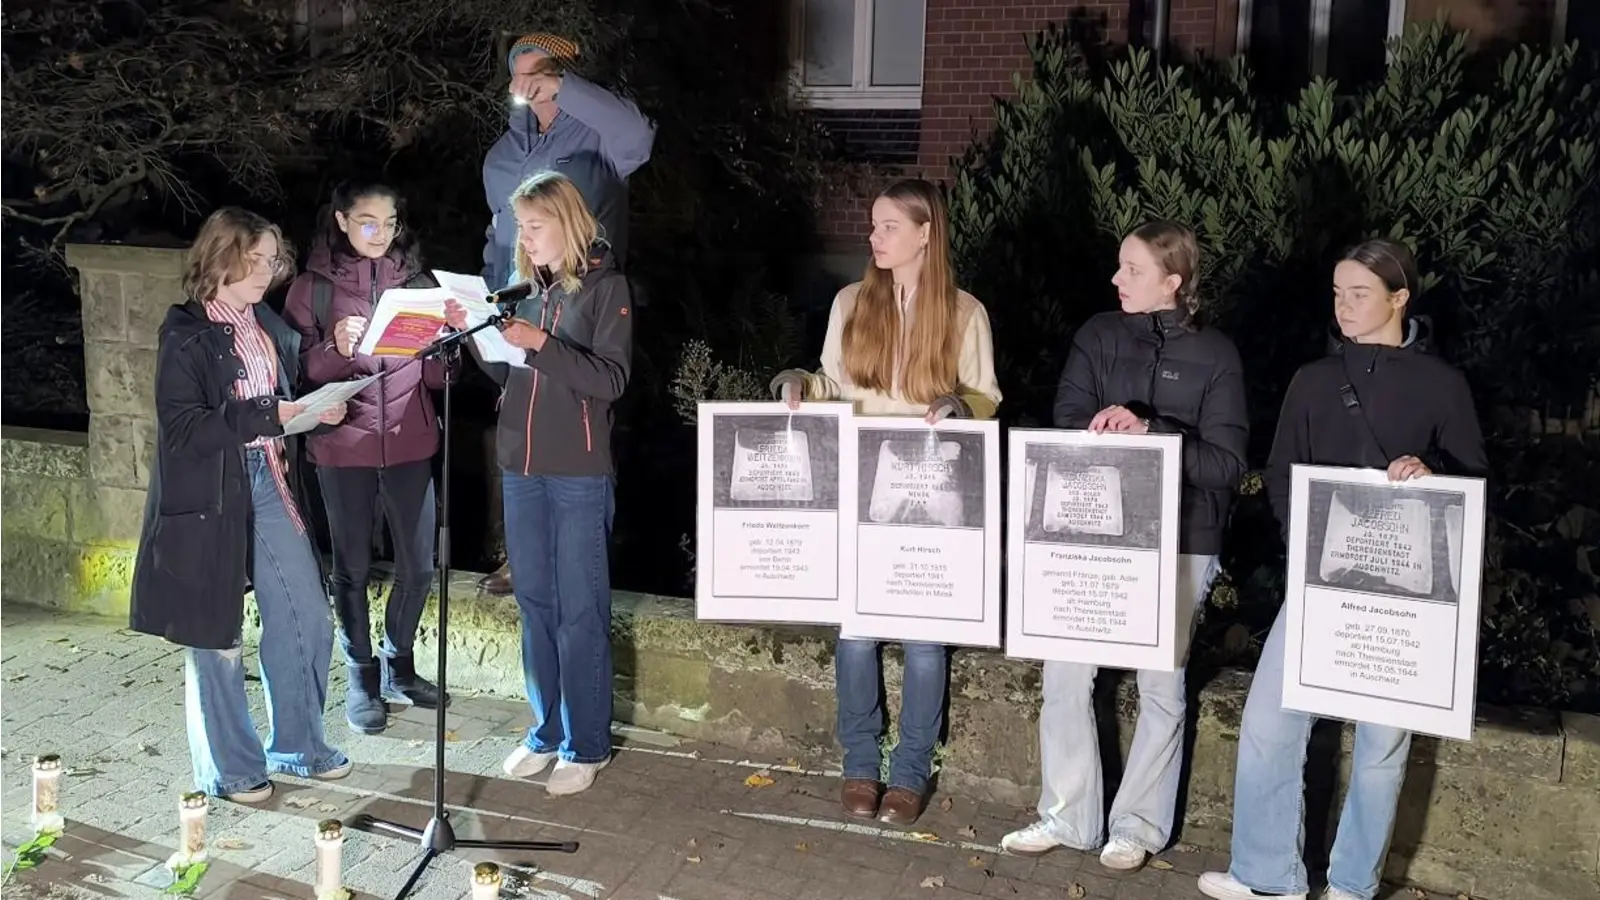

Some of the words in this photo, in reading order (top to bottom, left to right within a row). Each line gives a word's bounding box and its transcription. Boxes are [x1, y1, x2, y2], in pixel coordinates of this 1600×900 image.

[1351, 518, 1410, 534] JACOBSOHN
[918, 546, 942, 554] Hirsch
[1050, 552, 1088, 562] Franziska
[1089, 554, 1132, 564] Jacobsohn
[1370, 556, 1388, 565] JULI
[1353, 563, 1400, 576] AUSCHWITZ
[1341, 602, 1367, 612] Alfred
[1368, 606, 1417, 620] Jacobsohn
[1363, 643, 1401, 657] Hamburg
[1360, 672, 1400, 685] Auschwitz
